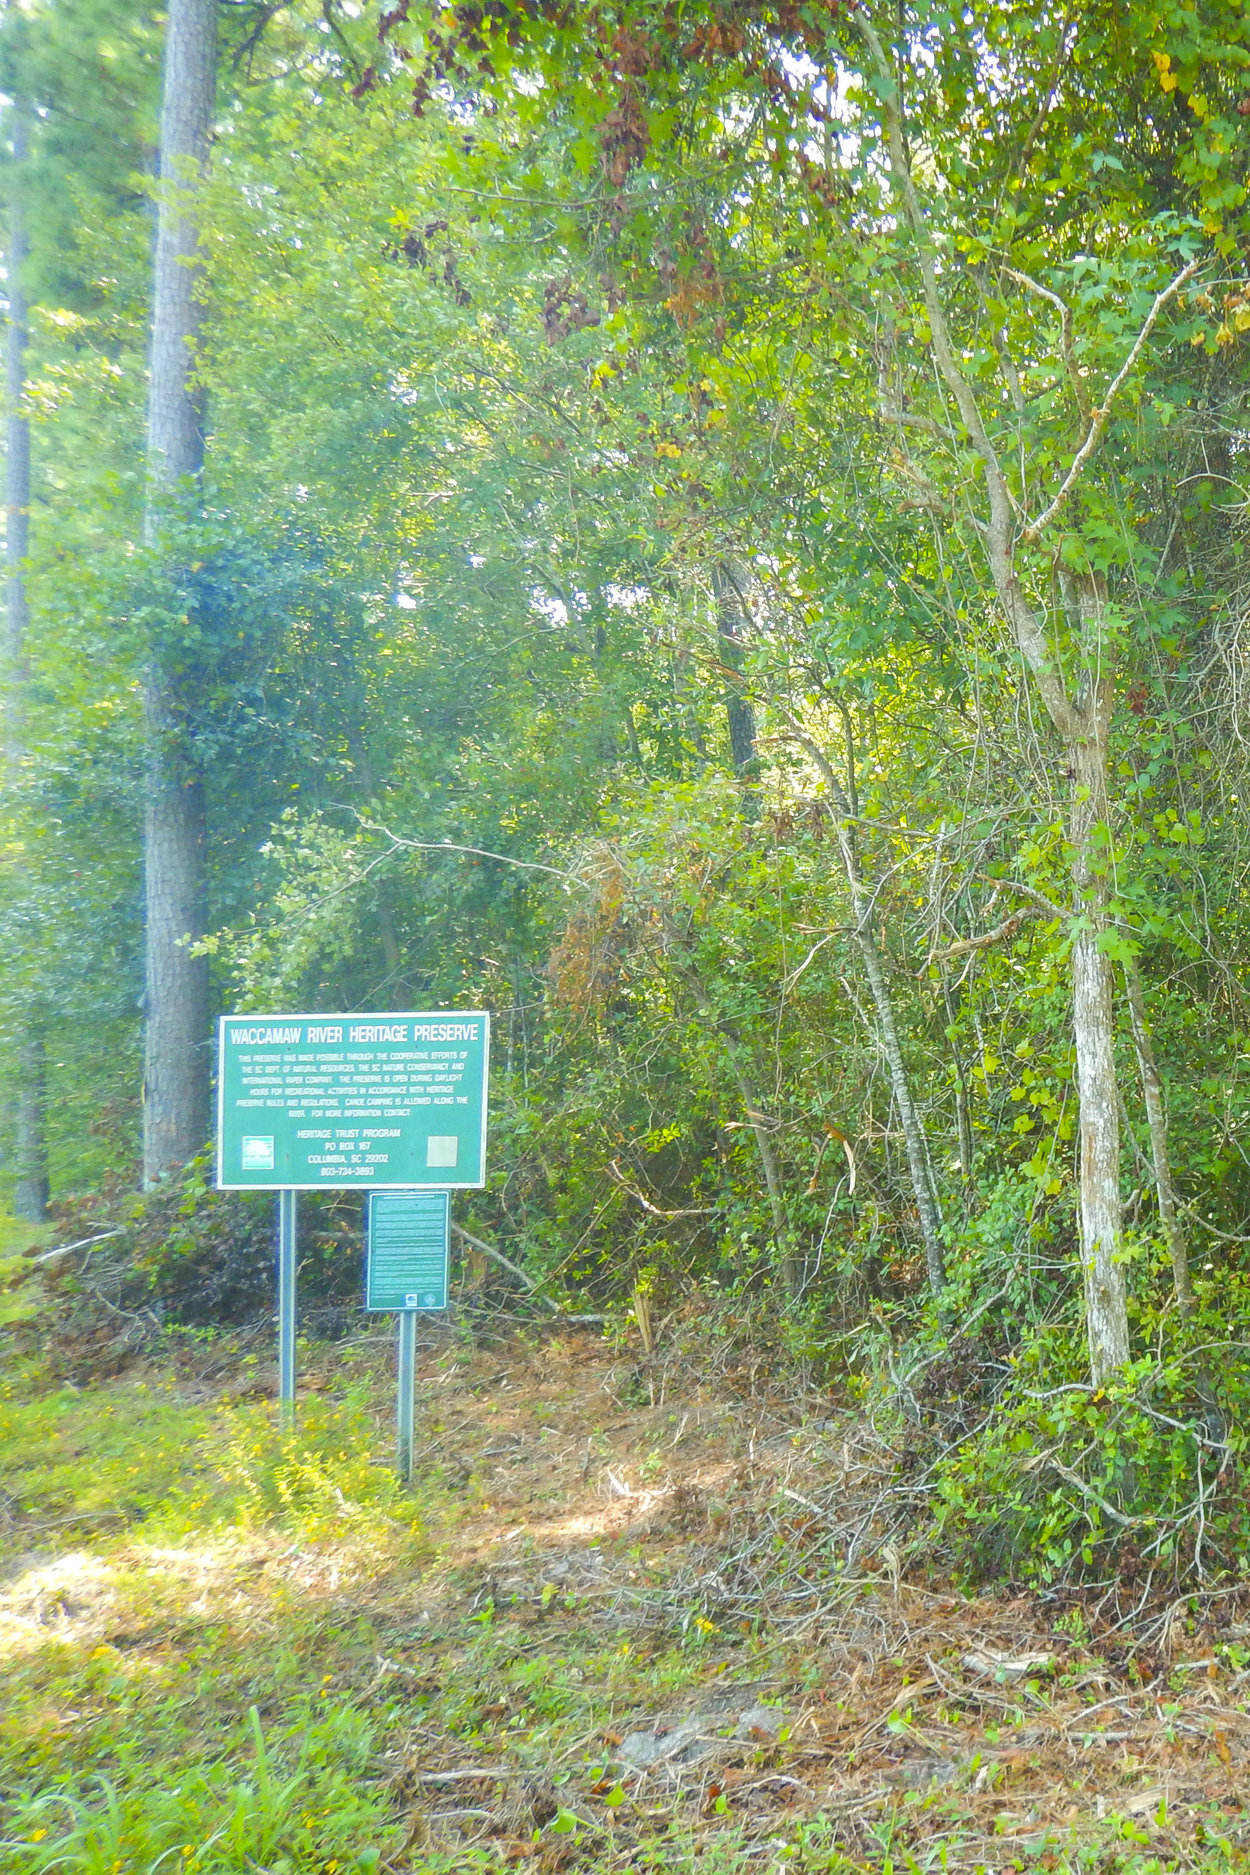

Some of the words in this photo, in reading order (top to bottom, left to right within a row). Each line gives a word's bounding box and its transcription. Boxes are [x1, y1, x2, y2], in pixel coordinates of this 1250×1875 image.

[230, 1027, 301, 1045] WACCAMAW
[307, 1026, 343, 1043] RIVER
[349, 1025, 408, 1042] HERITAGE
[414, 1024, 478, 1041] PRESERVE
[253, 1054, 281, 1062] PRESERVE
[317, 1053, 344, 1061] POSSIBLE
[377, 1052, 388, 1060] THE
[242, 1066, 253, 1074] THE
[283, 1065, 291, 1073] OF
[293, 1065, 317, 1073] NATURAL
[358, 1064, 370, 1072] THE
[372, 1063, 381, 1071] SC
[383, 1063, 405, 1071] NATURE
[407, 1063, 449, 1071] CONSERVANCY
[451, 1062, 465, 1070] AND
[242, 1077, 283, 1085] INTERNATIONAL
[286, 1076, 304, 1084] PAPER
[339, 1075, 351, 1083] THE
[353, 1075, 382, 1083] PRESERVE
[393, 1074, 409, 1082] OPEN
[411, 1074, 433, 1082] DURING
[250, 1088, 270, 1096] HOURS
[285, 1087, 325, 1095] RECREATIONAL
[327, 1087, 358, 1095] ACTIVITIES
[360, 1086, 367, 1094] IN
[368, 1086, 407, 1094] ACCORDANCE
[426, 1085, 455, 1093] HERITAGE
[345, 1098, 365, 1106] CANOE
[367, 1098, 393, 1106] CAMPING
[395, 1097, 402, 1105] IS
[403, 1097, 431, 1105] ALLOWED
[433, 1096, 454, 1104] ALONG
[456, 1096, 468, 1104] THE
[311, 1109, 323, 1117] FOR
[325, 1109, 343, 1117] MORE
[343, 1109, 382, 1117] INFORMATION
[296, 1130, 332, 1139] HERITAGE
[335, 1129, 360, 1139] TRUST
[363, 1129, 401, 1138] PROGRAM
[325, 1142, 337, 1151] PO
[339, 1142, 356, 1151] BOX
[351, 1154, 362, 1164] SC
[365, 1154, 389, 1163] 29202
